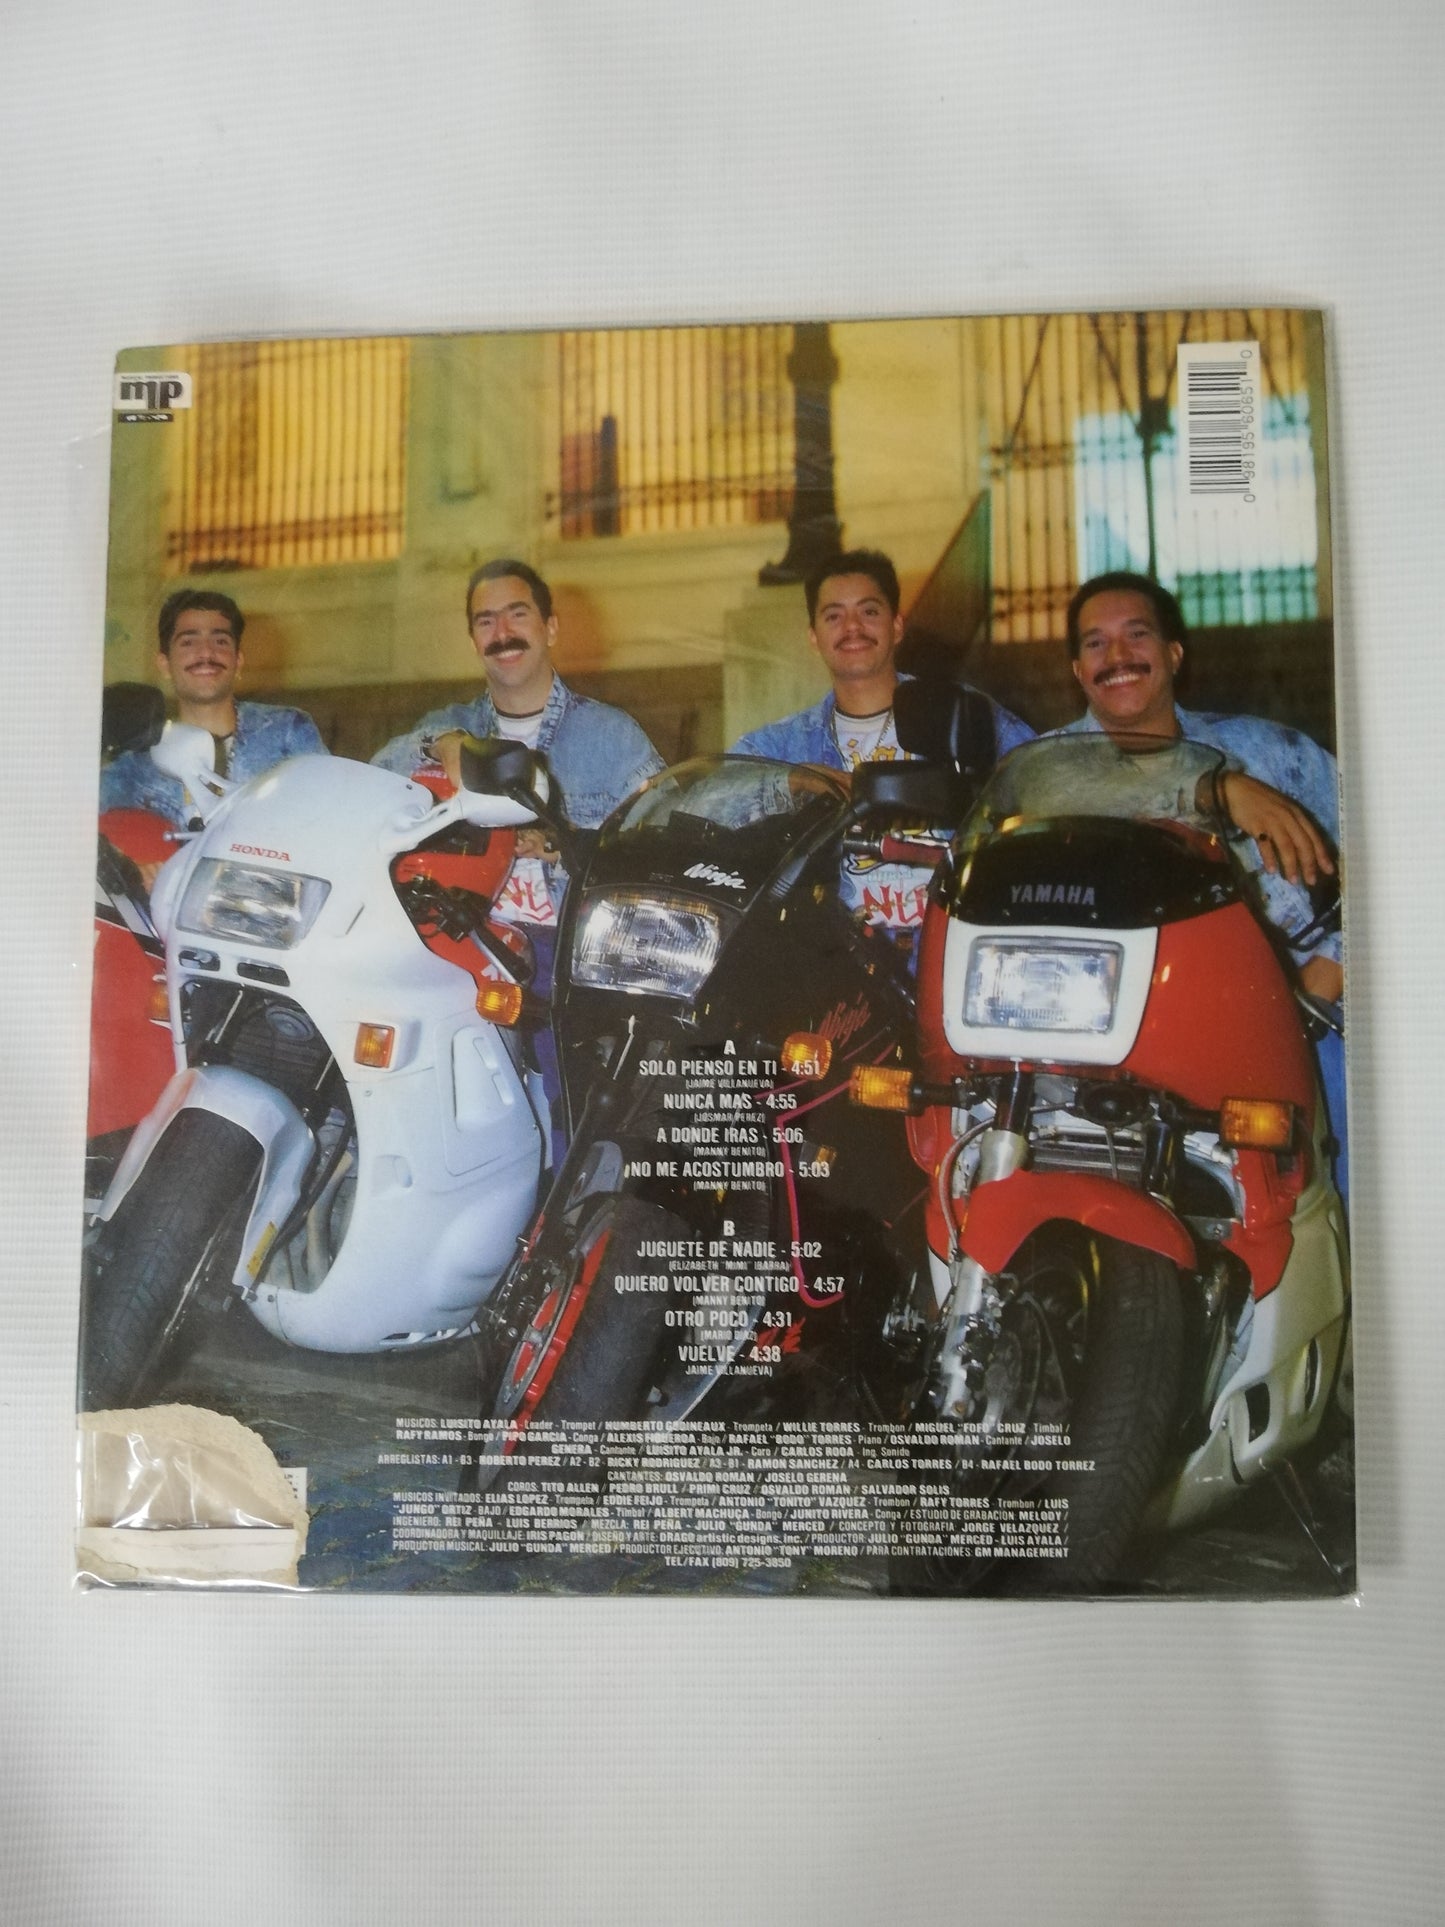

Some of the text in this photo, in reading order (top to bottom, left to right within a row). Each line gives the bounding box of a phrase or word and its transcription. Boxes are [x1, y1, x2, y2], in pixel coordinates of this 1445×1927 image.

[1240, 349, 1255, 503] 0 98195 60651 0
[230, 843, 290, 861] HONDA
[683, 862, 747, 889] Ninja
[1010, 884, 1096, 906] YAMAHA
[723, 1040, 736, 1055] A
[639, 1060, 820, 1076] SOLO PIENSO EN TI 4:51
[664, 1094, 797, 1109] NUNCA MAS 4:55
[656, 1128, 803, 1143] A DONDE IRAS 5:06
[631, 1162, 830, 1177] NO ME ACOSTUMBRO 5:03
[723, 1221, 735, 1237] B
[637, 1241, 822, 1258] JUGUETE DE NADIE 5:02
[615, 1276, 845, 1294] QUIERO VOLVER CONTIGO 4:57
[664, 1311, 792, 1327] OTRO POCO 4:31
[678, 1346, 781, 1362] VUELVE 4:38
[483, 1420, 518, 1429] AYALA
[783, 1422, 817, 1432] WILLIE
[820, 1423, 860, 1432] TORRES
[915, 1423, 955, 1433] MIGUEL
[997, 1423, 1026, 1433] CRUZ
[424, 1430, 462, 1440] RAMOS
[607, 1433, 644, 1443] ALEXIS
[729, 1434, 768, 1444] RAFAEL
[812, 1435, 852, 1444] TORRES
[1031, 1435, 1071, 1446] JOSELO
[690, 1446, 724, 1456] AYALA
[781, 1447, 822, 1457] CARLOS
[528, 1456, 560, 1466] PEREZ
[570, 1457, 581, 1466] A2
[748, 1459, 787, 1469] RAMON
[789, 1459, 838, 1469] SANCHEZ
[867, 1460, 909, 1469] CARLOS
[911, 1460, 952, 1469] TORRES
[982, 1460, 1021, 1470] RAFAEL
[1056, 1461, 1095, 1471] TORREZ
[716, 1472, 754, 1482] ROMAN
[765, 1473, 804, 1483] JOSELO
[541, 1482, 564, 1492] TITO
[567, 1483, 599, 1493] ALLEN
[610, 1483, 643, 1493] PEDRO
[646, 1483, 679, 1493] BRULL
[722, 1485, 750, 1494] CRUZ
[812, 1485, 850, 1495] ROMAN
[861, 1485, 917, 1495] SALVADOR
[919, 1485, 950, 1495] SOLIS
[485, 1493, 515, 1504] ELIAS
[517, 1494, 549, 1504] LOPEZ
[603, 1496, 632, 1505] EDDIE
[719, 1497, 765, 1506] ANTONIO
[819, 1497, 866, 1508] VAZQUEZ
[950, 1498, 989, 1508] TORRES
[1045, 1499, 1068, 1509] LUIS
[654, 1509, 693, 1518] ALBERT
[791, 1509, 829, 1519] JUNITO
[832, 1509, 868, 1519] RIVERA
[1019, 1511, 1061, 1521] MELODY
[507, 1518, 529, 1528] LUIS
[654, 1519, 682, 1530] PEÑA
[695, 1521, 725, 1531] JULIO
[783, 1521, 825, 1531] MERCED
[962, 1523, 995, 1532] JORGE
[1000, 1523, 1059, 1535] VELAZQUEZ
[527, 1530, 547, 1541] IRIS
[868, 1534, 898, 1544] JULIO
[951, 1535, 993, 1545] MERCED
[1001, 1535, 1025, 1545] LUIS
[1027, 1535, 1062, 1545] AYALA
[489, 1542, 519, 1552] JULIO
[570, 1543, 611, 1553] MERCED
[726, 1545, 772, 1556] ANTONIO
[975, 1547, 991, 1557] GM
[994, 1547, 1069, 1558] MANAGEMENT
[665, 1556, 709, 1567] TEL/FAX
